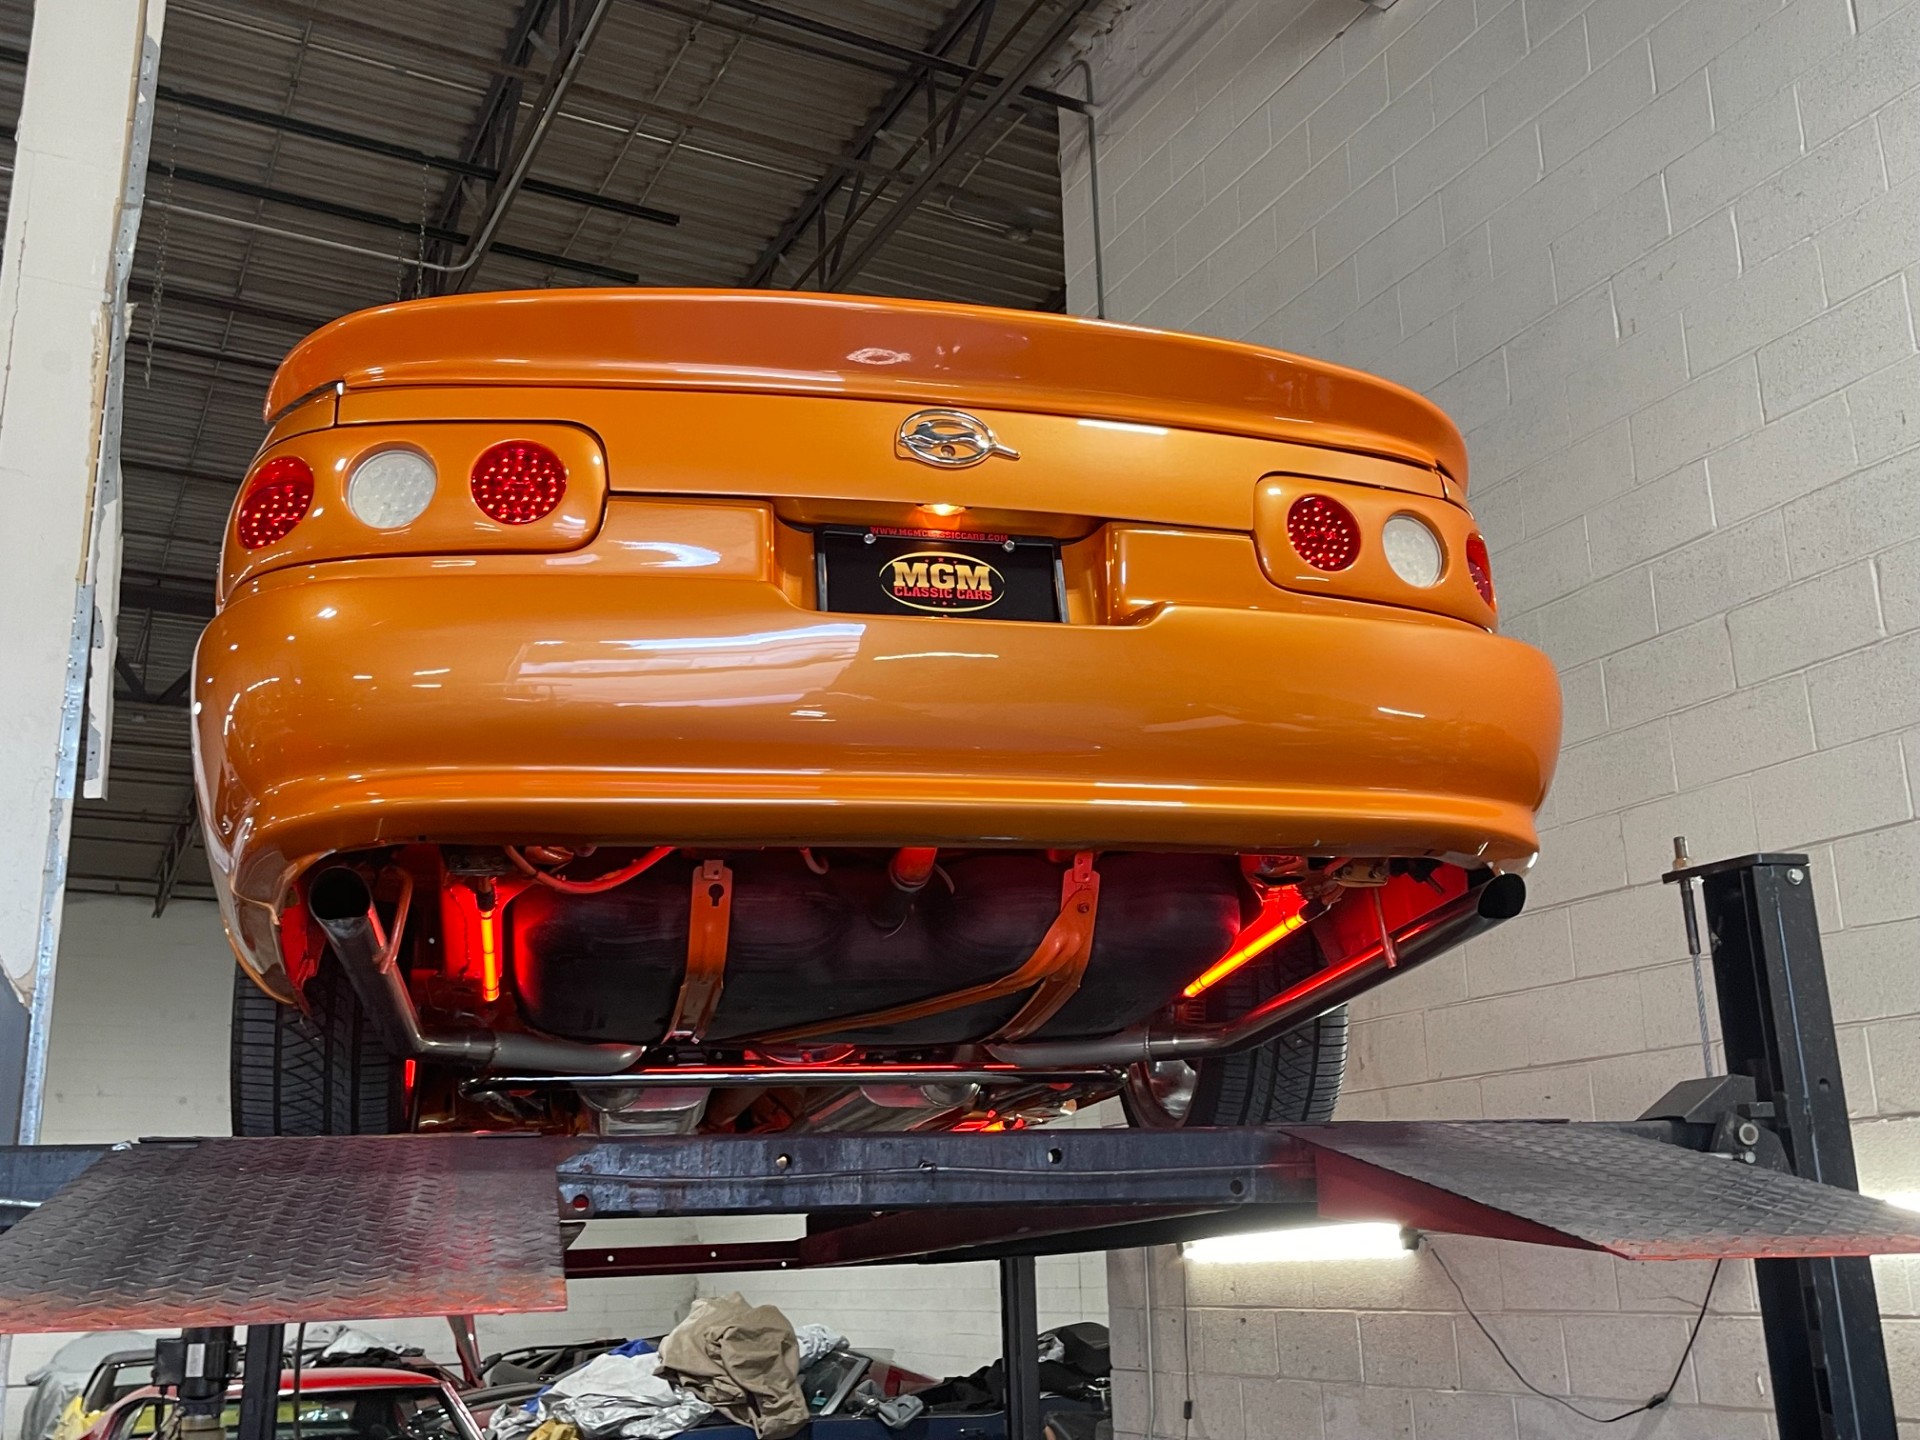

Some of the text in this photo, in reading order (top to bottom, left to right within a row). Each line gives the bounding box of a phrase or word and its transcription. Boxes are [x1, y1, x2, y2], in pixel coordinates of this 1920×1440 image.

[892, 561, 992, 590] MGM
[894, 586, 993, 601] CLASSIC CARS
